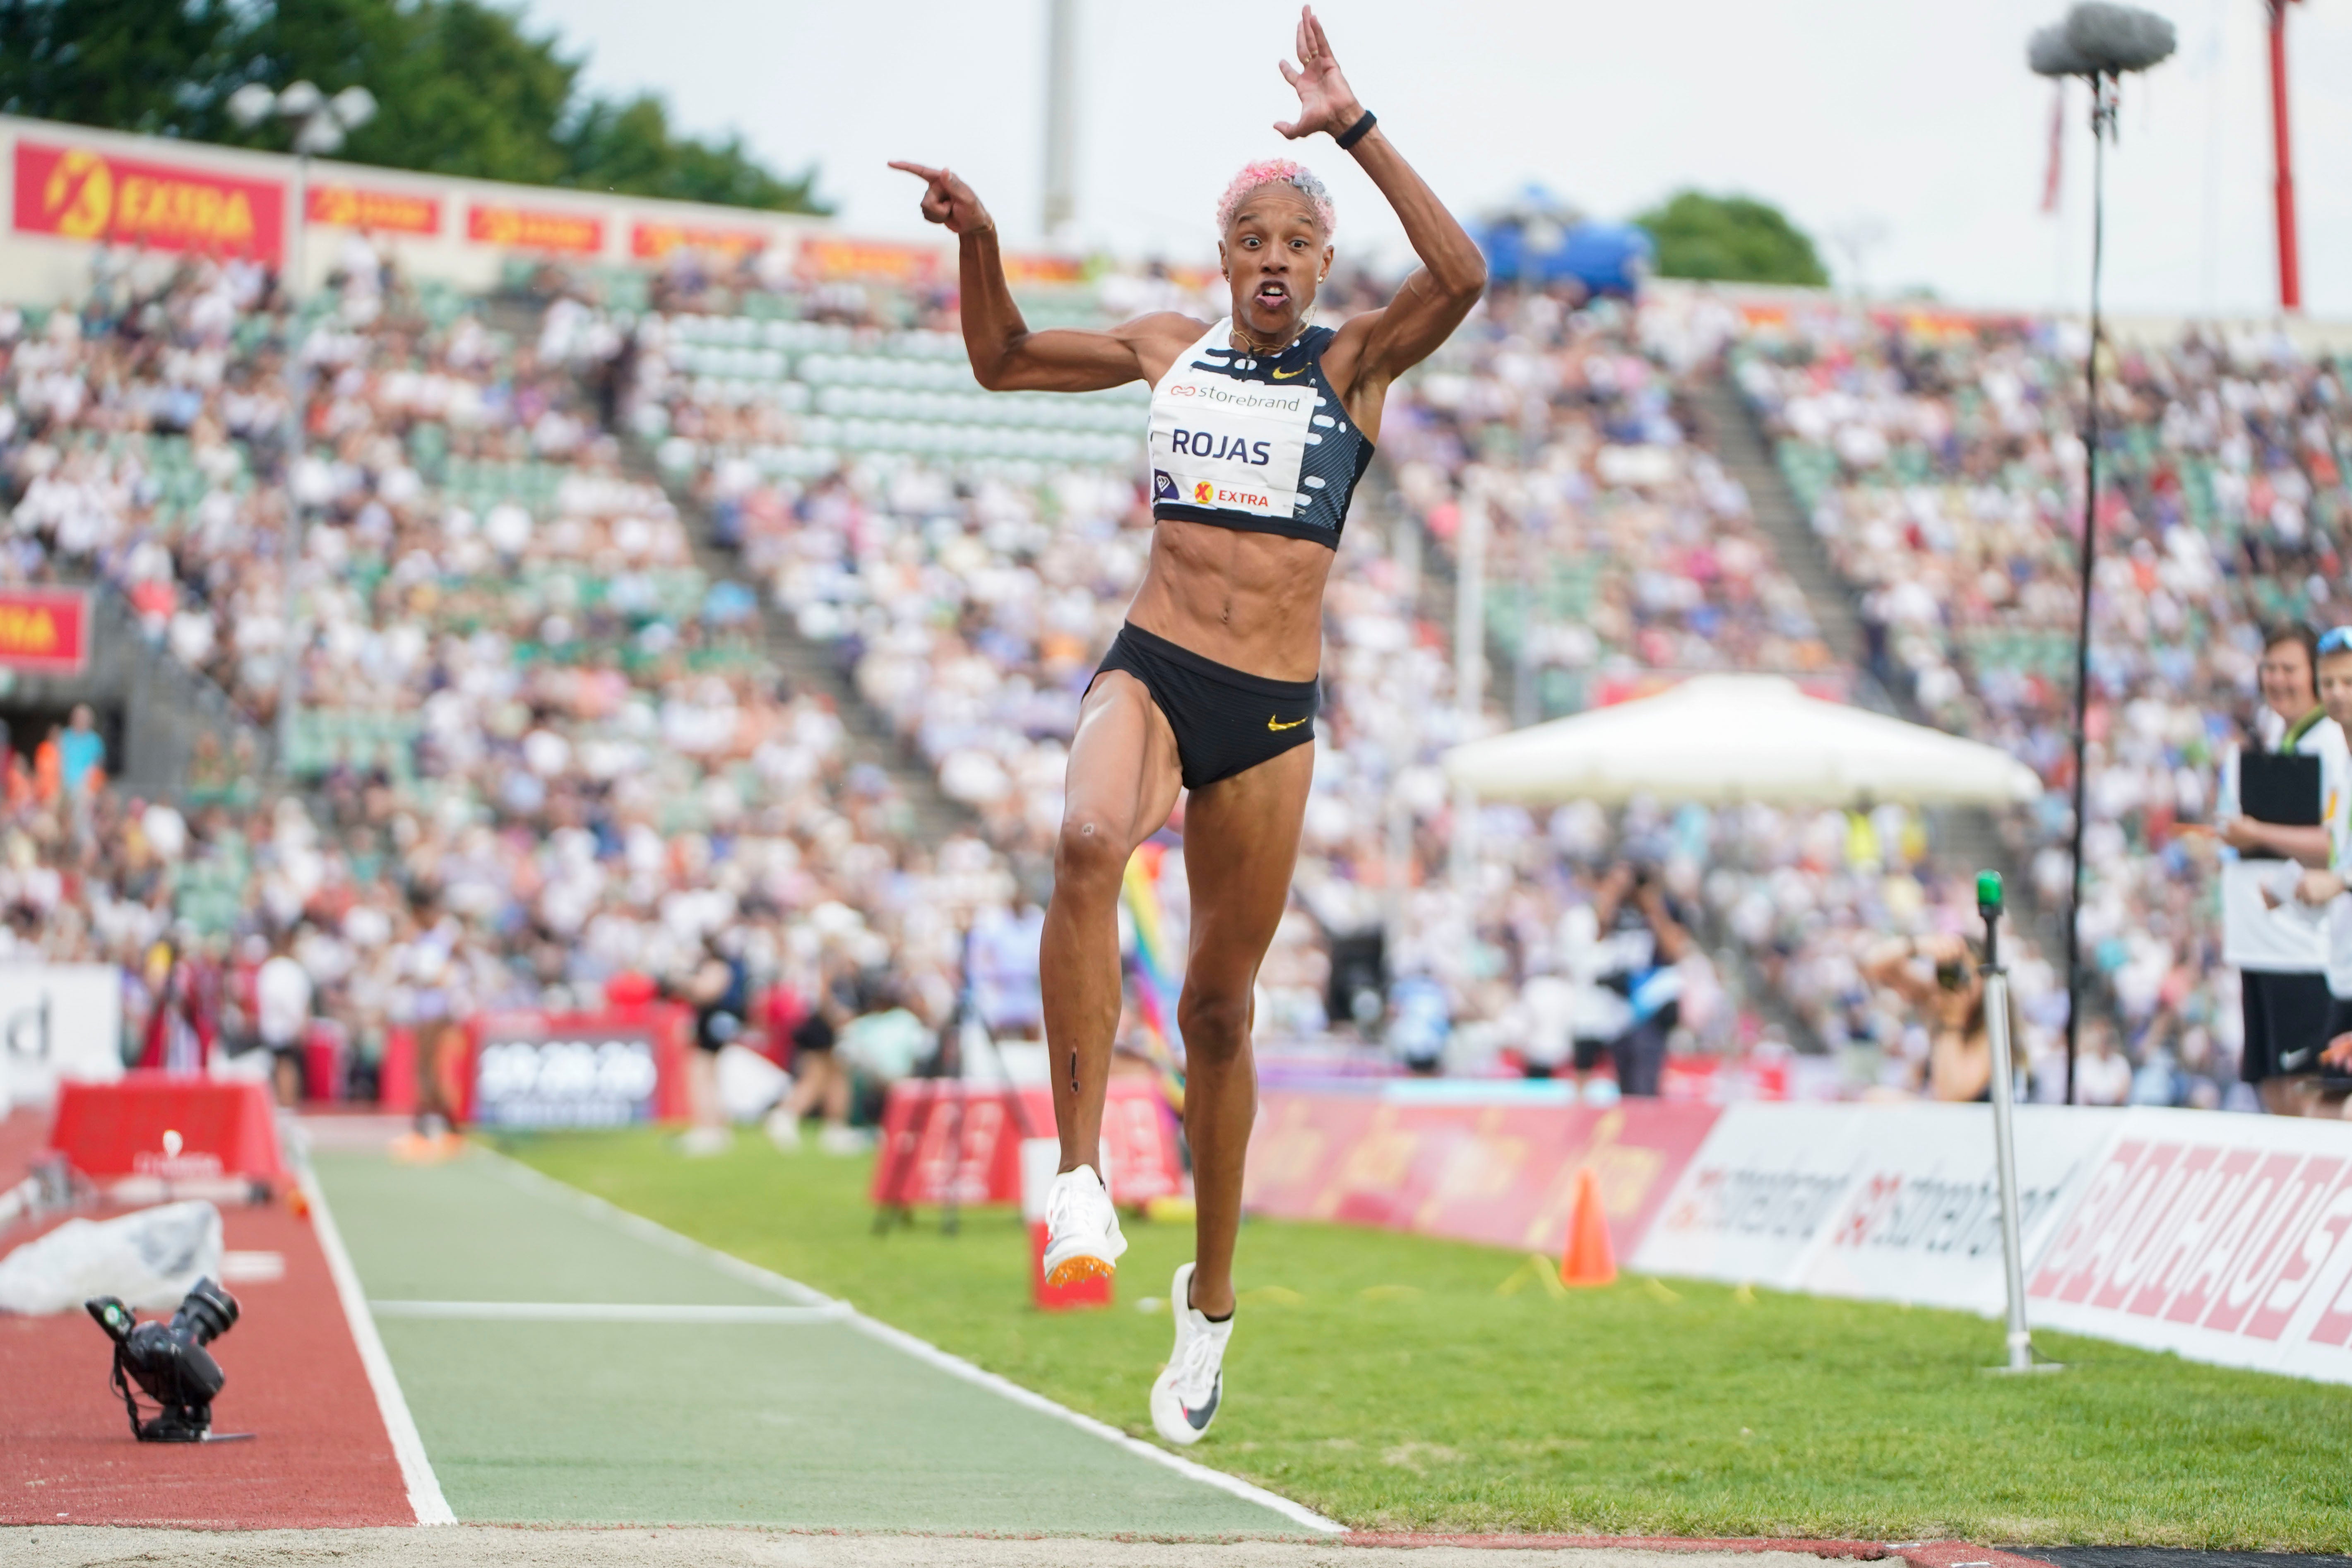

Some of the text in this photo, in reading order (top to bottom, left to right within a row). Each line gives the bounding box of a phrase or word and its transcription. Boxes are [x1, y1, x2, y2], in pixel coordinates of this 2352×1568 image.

[1199, 386, 1300, 411] storebrand
[1172, 429, 1271, 466] ROJAS
[1219, 490, 1269, 507] EXTRA
[2047, 1159, 2352, 1313] BAUHAUS
